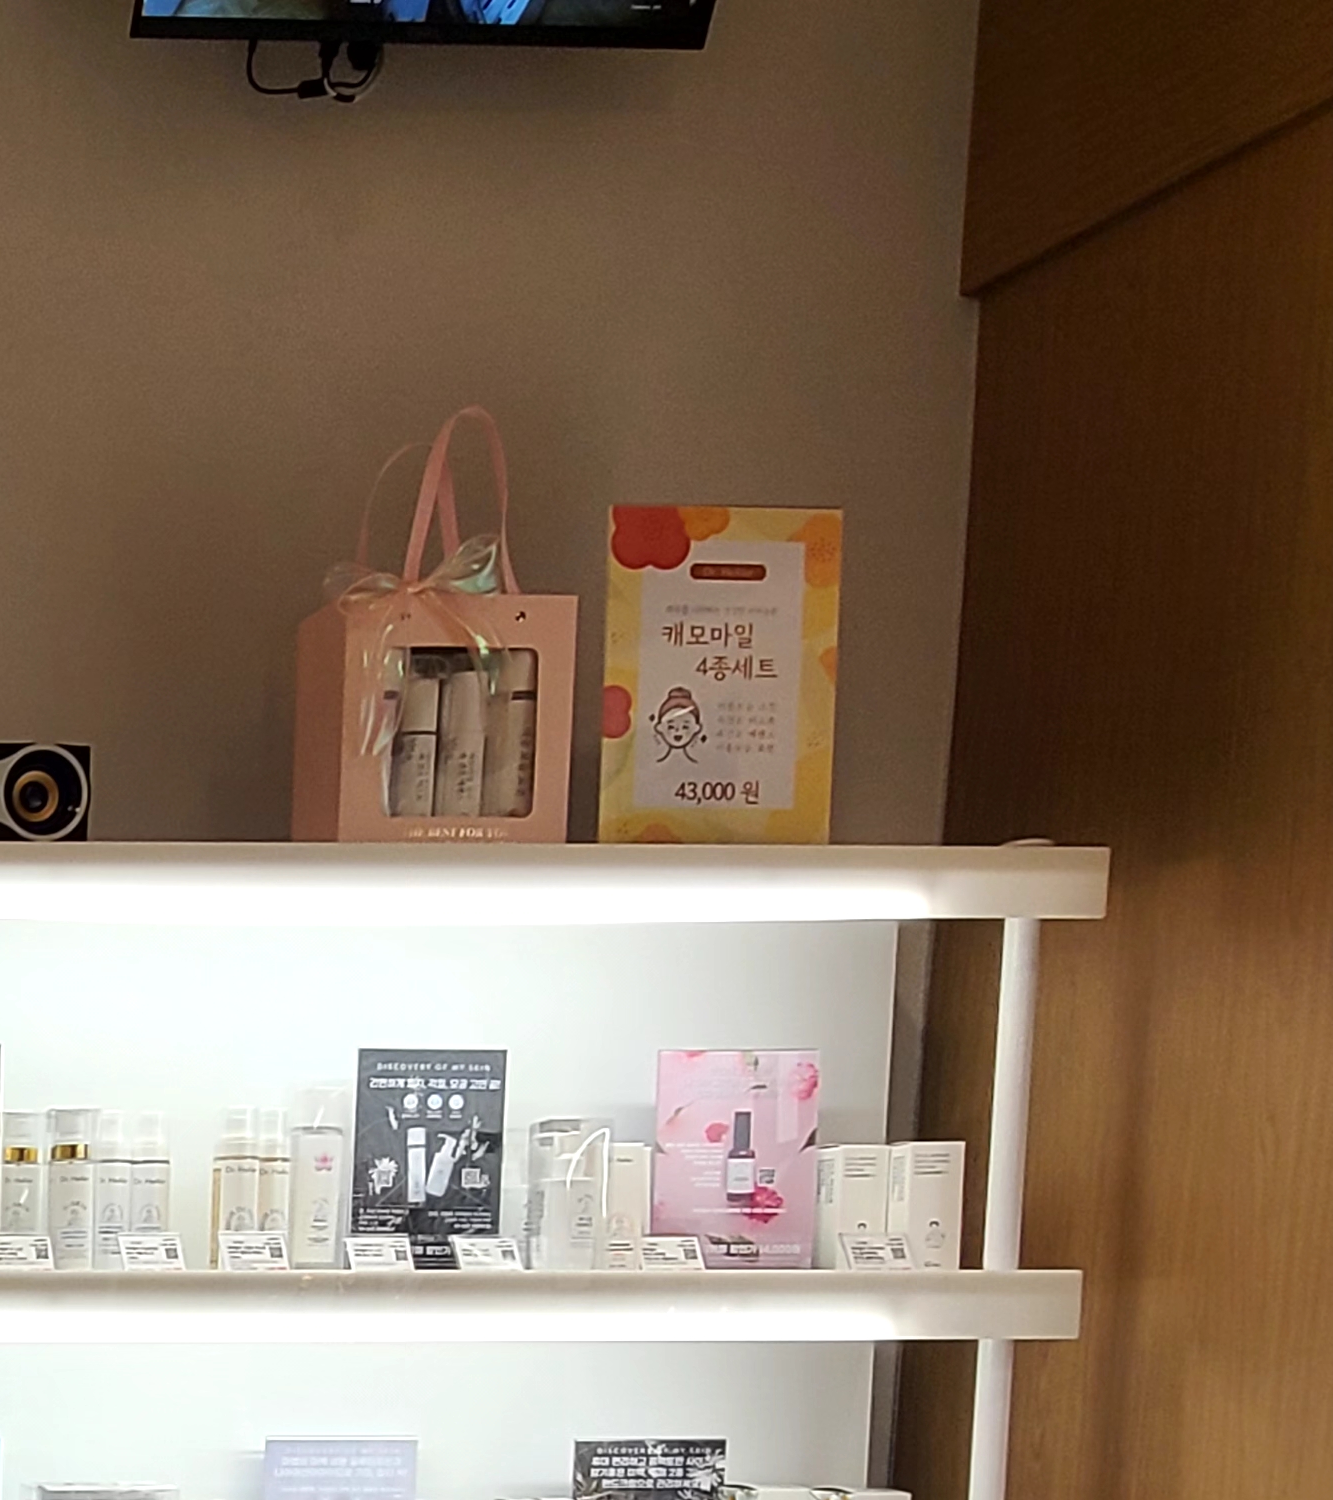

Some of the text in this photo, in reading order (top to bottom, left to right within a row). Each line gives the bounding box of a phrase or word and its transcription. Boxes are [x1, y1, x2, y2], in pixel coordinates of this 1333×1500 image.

[662, 622, 754, 649] 캐모마일
[695, 656, 779, 681] 4종세트
[675, 781, 760, 806] 43,000 원
